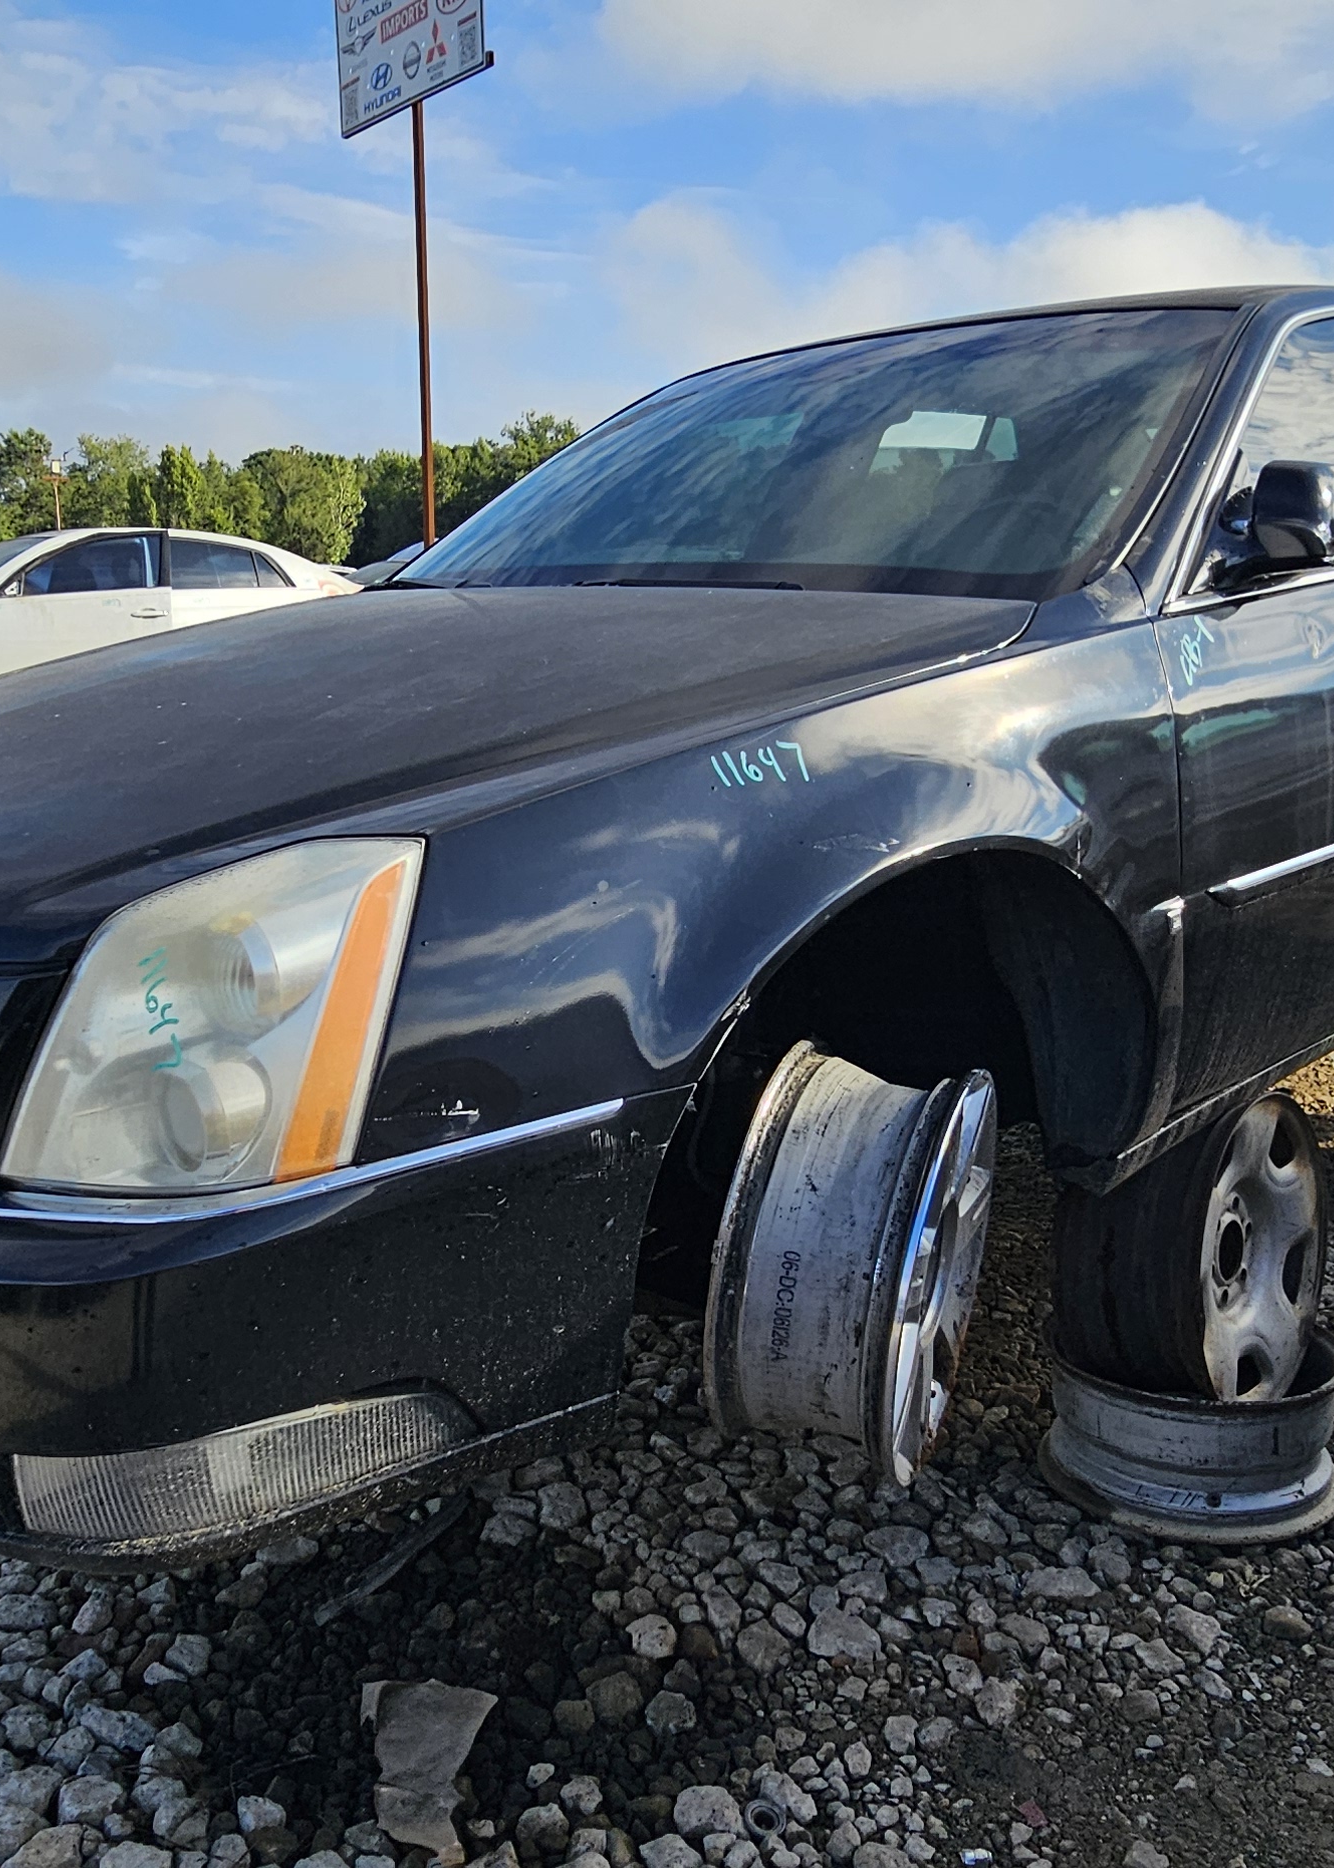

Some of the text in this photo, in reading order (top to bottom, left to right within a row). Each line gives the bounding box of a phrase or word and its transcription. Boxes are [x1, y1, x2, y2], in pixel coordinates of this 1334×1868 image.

[357, 0, 391, 26] LEXUS
[382, 2, 426, 40] IMPORTS
[364, 86, 402, 115] HYUNDAI
[710, 739, 810, 787] 11647
[137, 947, 183, 1071] 11647
